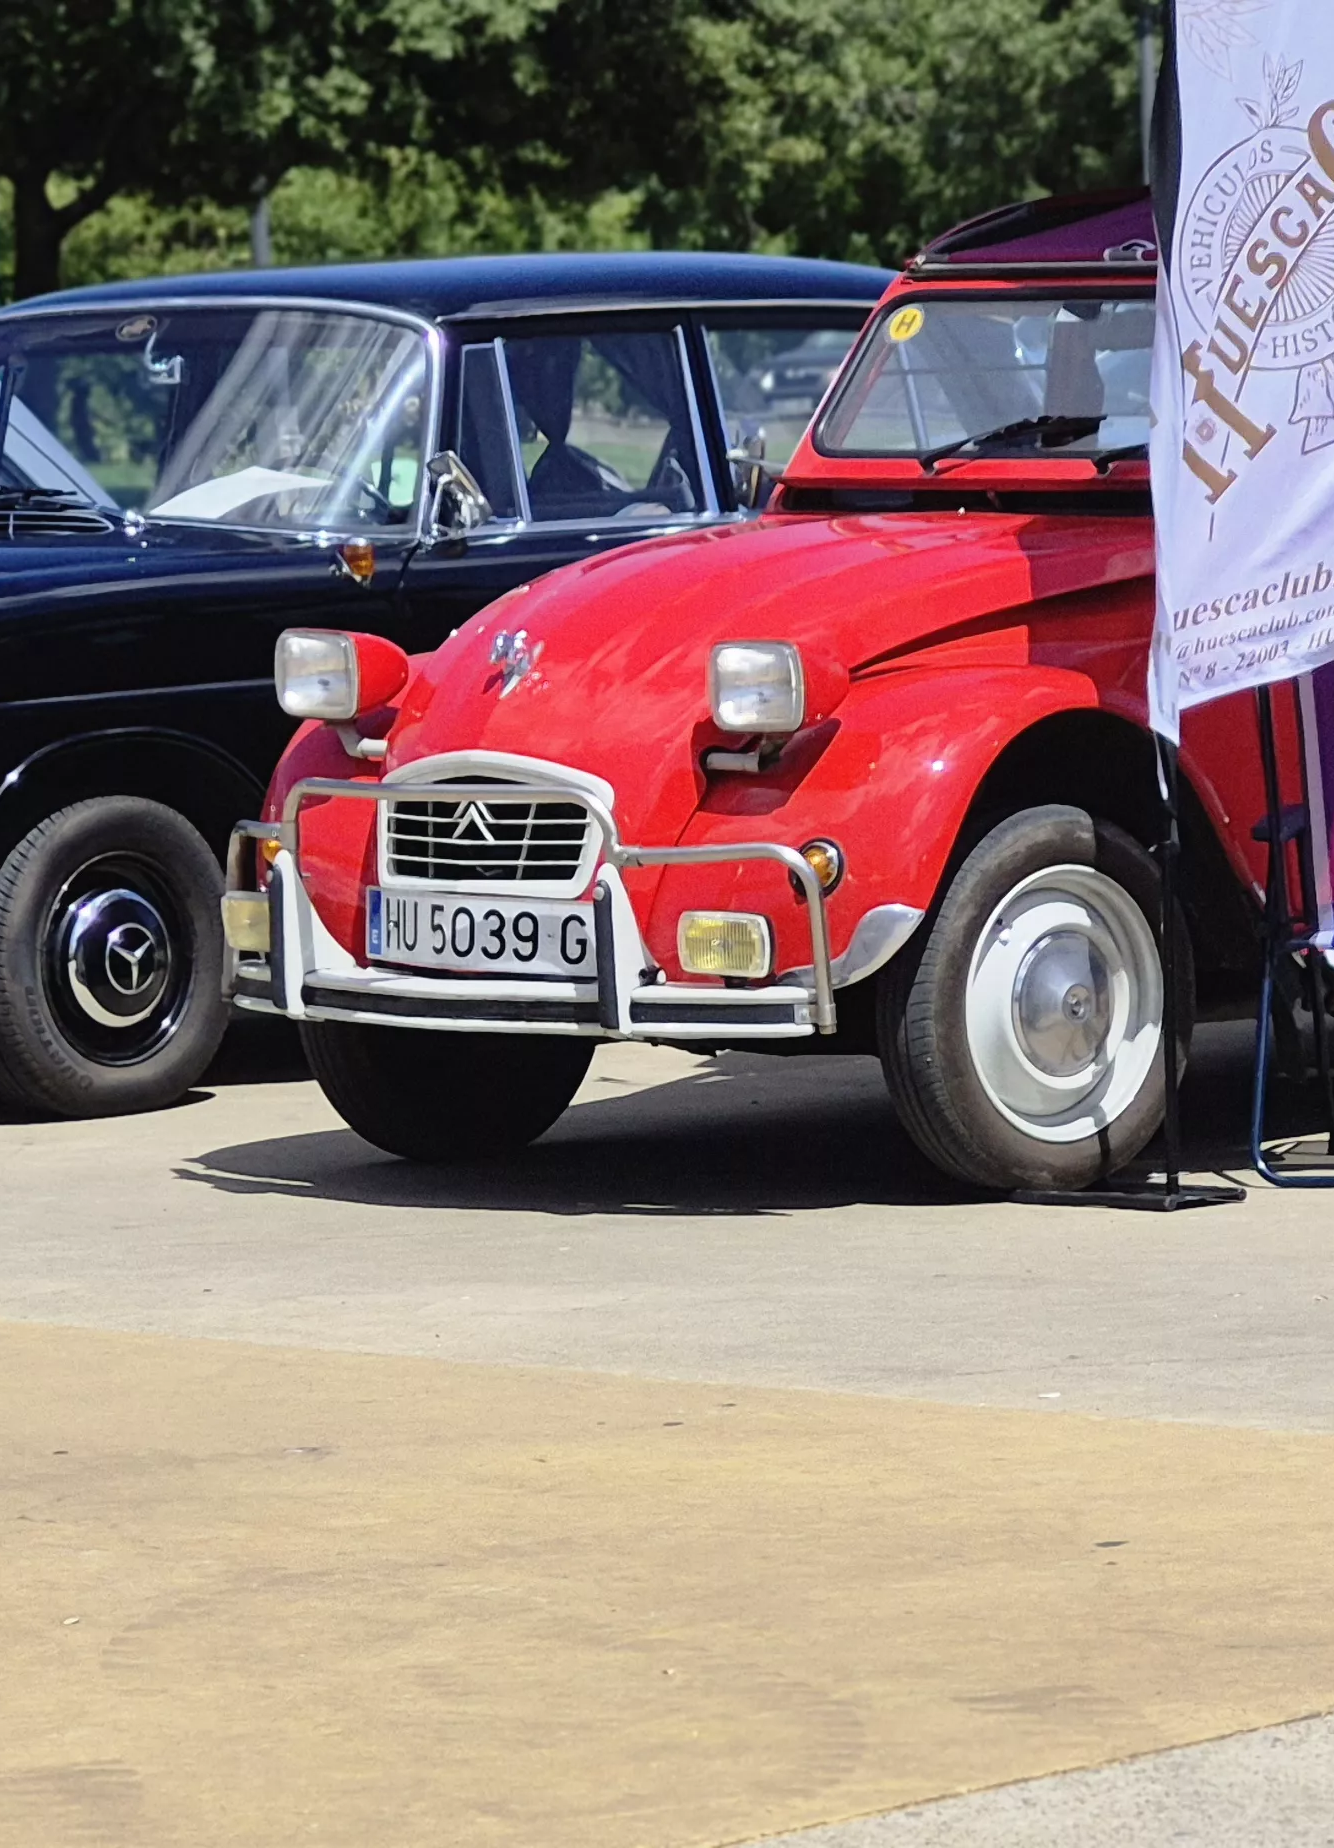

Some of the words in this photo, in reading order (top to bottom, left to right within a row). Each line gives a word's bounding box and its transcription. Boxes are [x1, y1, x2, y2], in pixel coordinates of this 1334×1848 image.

[895, 313, 918, 334] H
[1234, 639, 1290, 672] 22003
[385, 898, 418, 952] HU
[430, 903, 539, 963] 5039
[560, 913, 588, 965] G
